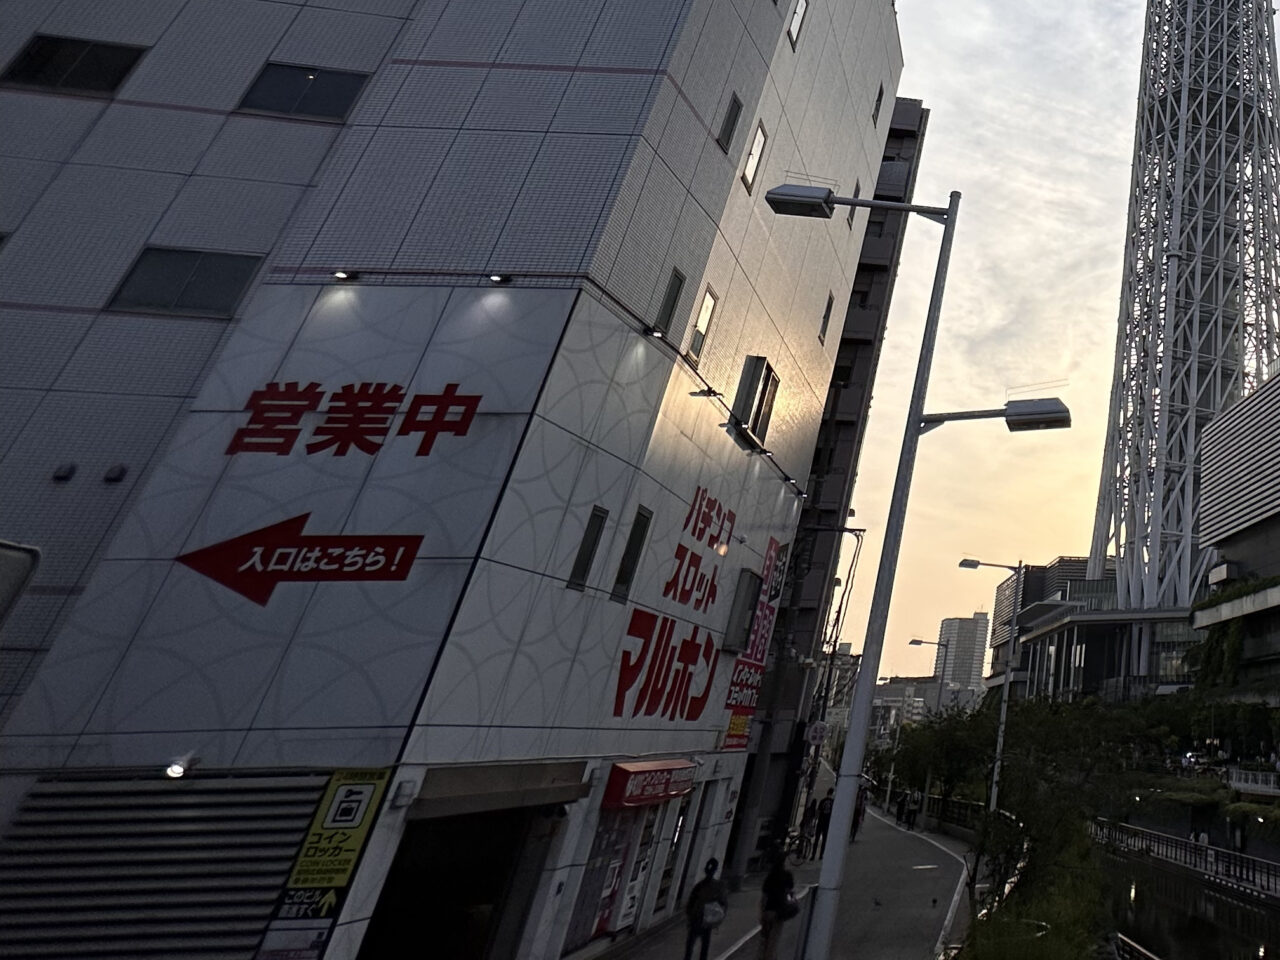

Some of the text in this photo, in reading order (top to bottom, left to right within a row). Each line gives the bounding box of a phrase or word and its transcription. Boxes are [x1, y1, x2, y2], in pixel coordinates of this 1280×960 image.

[224, 382, 483, 457] 営業中
[683, 486, 736, 549] パチンコ
[663, 543, 718, 614] スロット
[613, 608, 720, 721] マルホン
[304, 846, 356, 858] ロッカー
[308, 831, 352, 845] コイン
[284, 890, 323, 903] このビル
